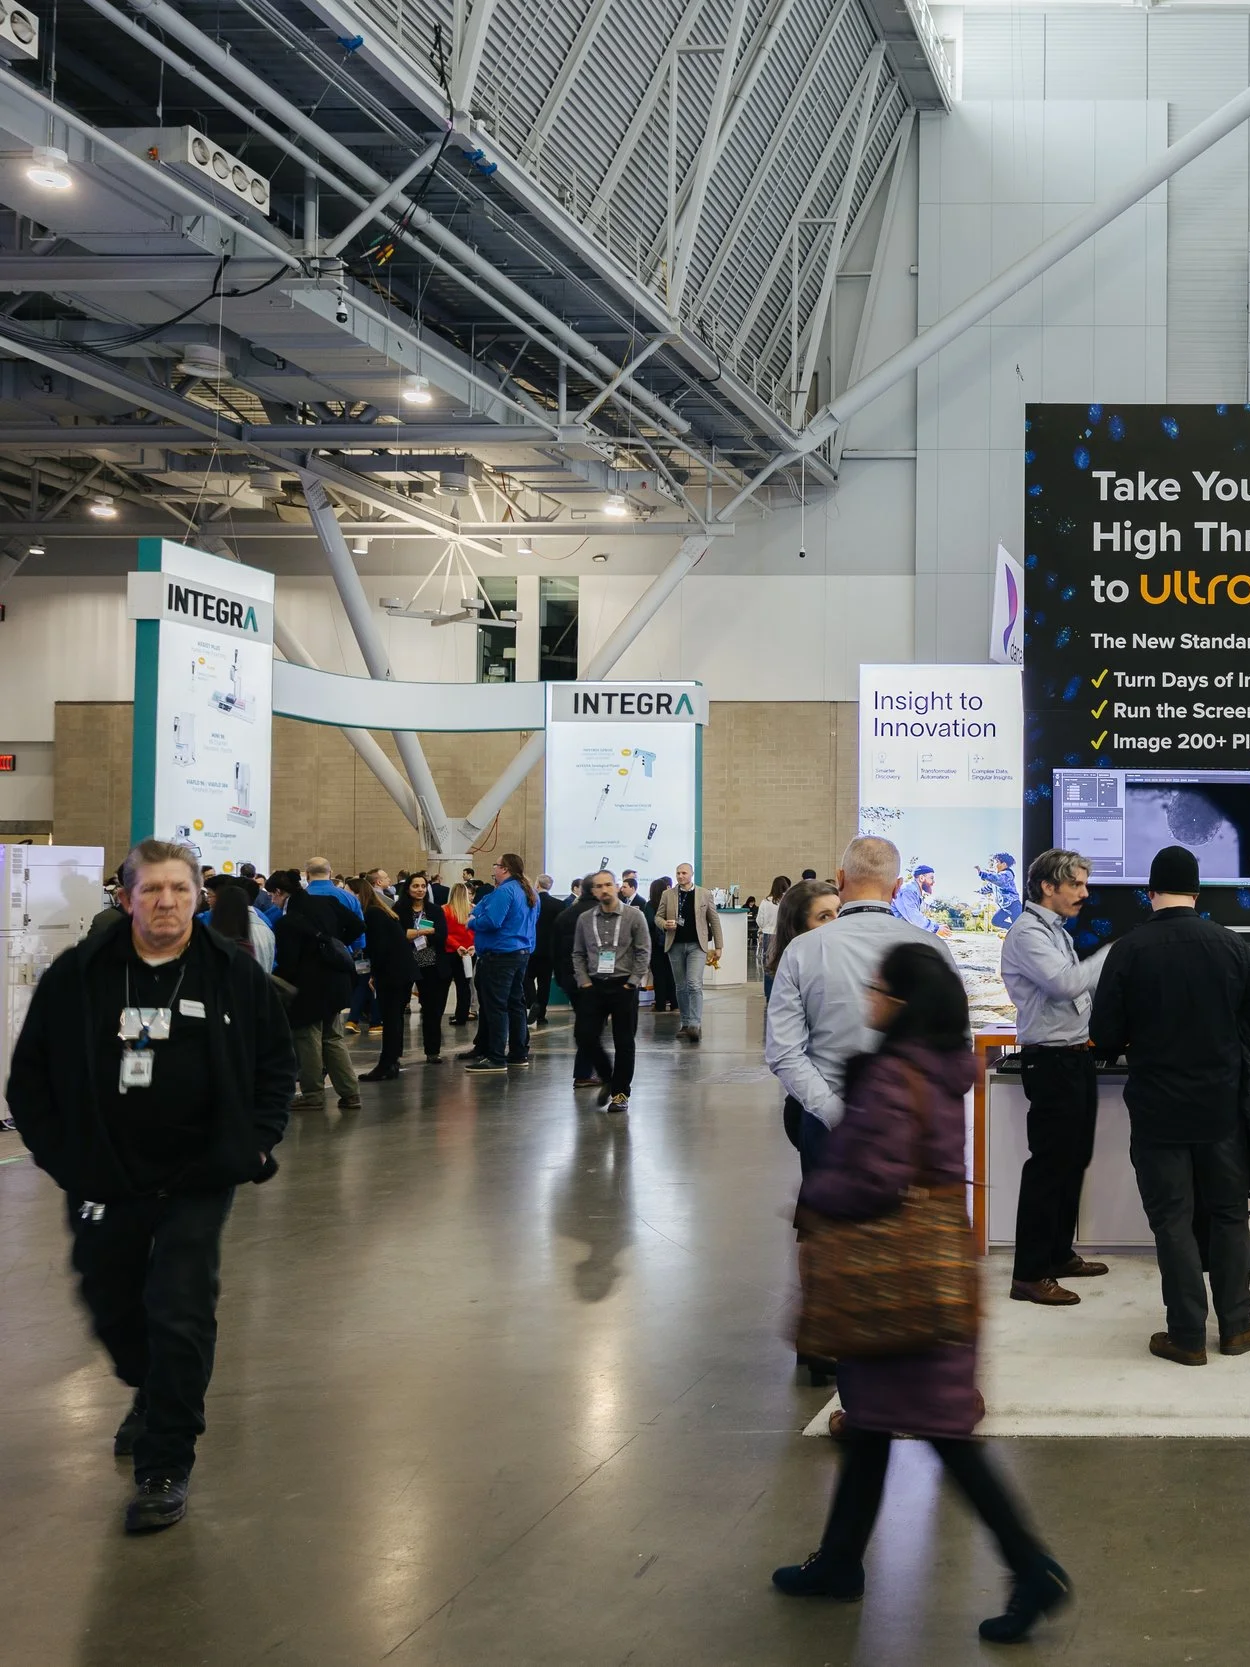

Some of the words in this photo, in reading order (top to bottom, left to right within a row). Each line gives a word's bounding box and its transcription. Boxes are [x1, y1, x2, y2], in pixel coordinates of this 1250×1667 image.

[1092, 470, 1181, 502] Take
[1093, 520, 1181, 560] High
[1090, 574, 1130, 603] to
[168, 583, 258, 632] INTEGRA
[1091, 633, 1127, 650] The
[1132, 633, 1176, 650] New
[1113, 671, 1156, 688] Turn
[1162, 671, 1209, 692] Days
[1213, 671, 1234, 688] of
[574, 692, 694, 715] INTEGRA
[874, 690, 953, 716] Insight
[959, 692, 983, 711] to
[1113, 702, 1151, 719] Run
[1156, 702, 1188, 719] the
[874, 717, 996, 738] Innovation
[1113, 733, 1173, 753] Image
[1177, 733, 1227, 750] 200+
